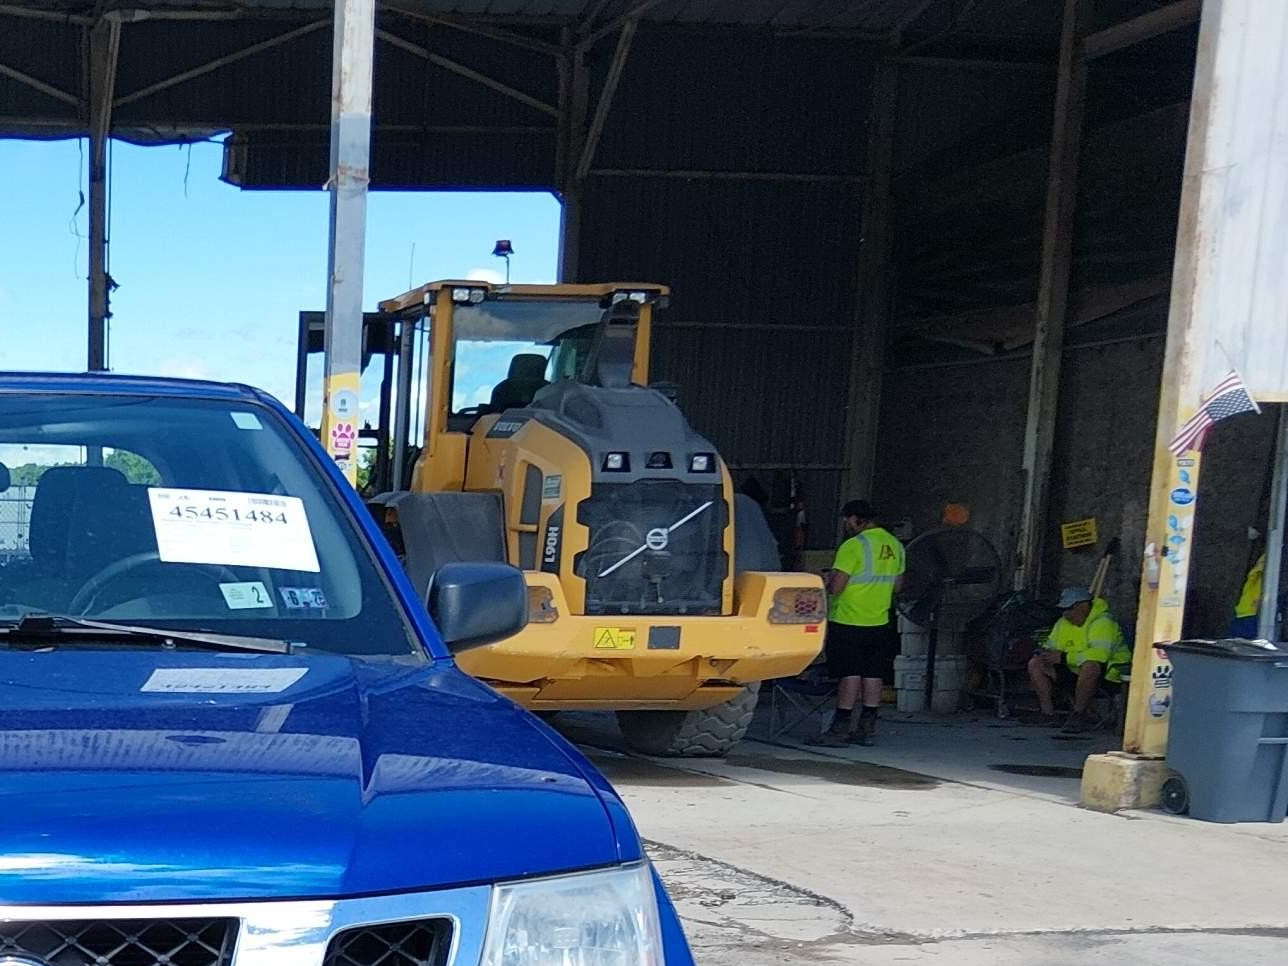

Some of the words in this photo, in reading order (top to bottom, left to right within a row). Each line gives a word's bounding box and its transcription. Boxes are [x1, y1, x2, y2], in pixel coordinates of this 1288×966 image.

[169, 505, 288, 525] 45451484
[544, 526, 560, 564] L90H
[252, 586, 265, 604] 2
